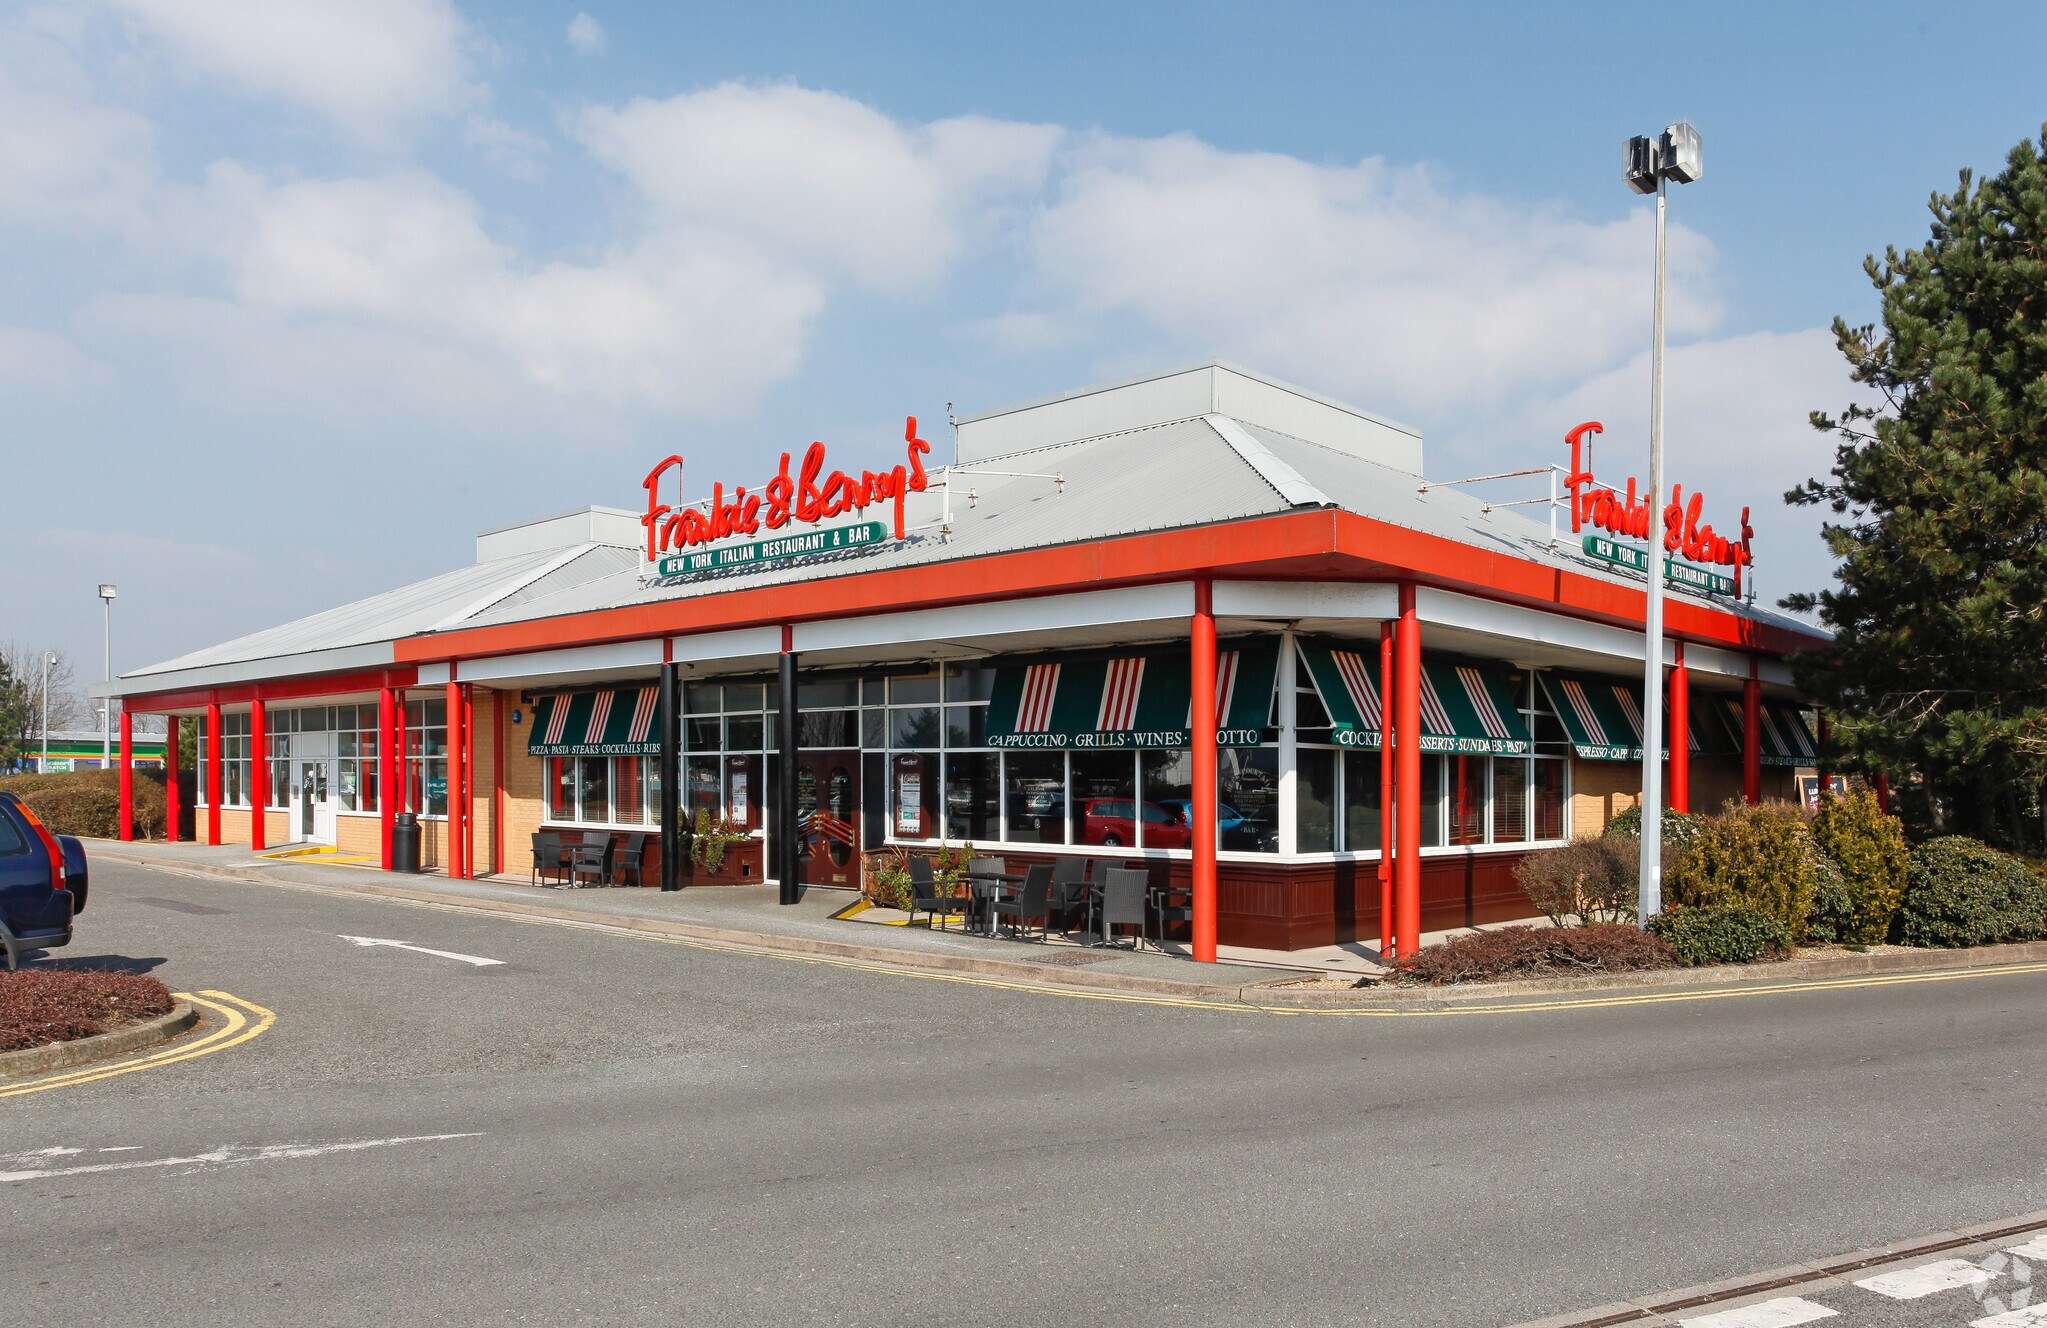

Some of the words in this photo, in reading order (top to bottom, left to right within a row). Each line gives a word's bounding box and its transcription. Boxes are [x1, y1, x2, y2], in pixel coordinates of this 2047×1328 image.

[641, 454, 761, 561] Frankie
[766, 452, 795, 529] &
[796, 416, 930, 540] Benny's
[1663, 484, 1683, 551] &
[666, 558, 684, 573] NEW
[691, 554, 712, 568] YORK
[720, 548, 754, 564] ITALIAN
[763, 533, 825, 557] RESTAURANT
[833, 531, 840, 546] &
[848, 526, 870, 543] BAR
[1596, 538, 1613, 557] NEW
[1618, 546, 1636, 565] YORK
[1671, 563, 1708, 586] RESTAURANT
[1711, 575, 1718, 589] &
[1719, 577, 1731, 592] BAR
[531, 745, 549, 755] PIZZA
[551, 745, 569, 755] PASTA
[571, 744, 599, 754] STEAKS
[601, 743, 641, 754] COCKTAILS
[643, 743, 660, 753] RIBS
[988, 733, 1067, 747] CAPPUCCINO
[1075, 732, 1125, 747] GRILLS
[1133, 731, 1182, 745] WINES
[1216, 729, 1258, 744] OTTO
[1458, 738, 1503, 752] SUNDAES
[1506, 741, 1528, 753] PASTA
